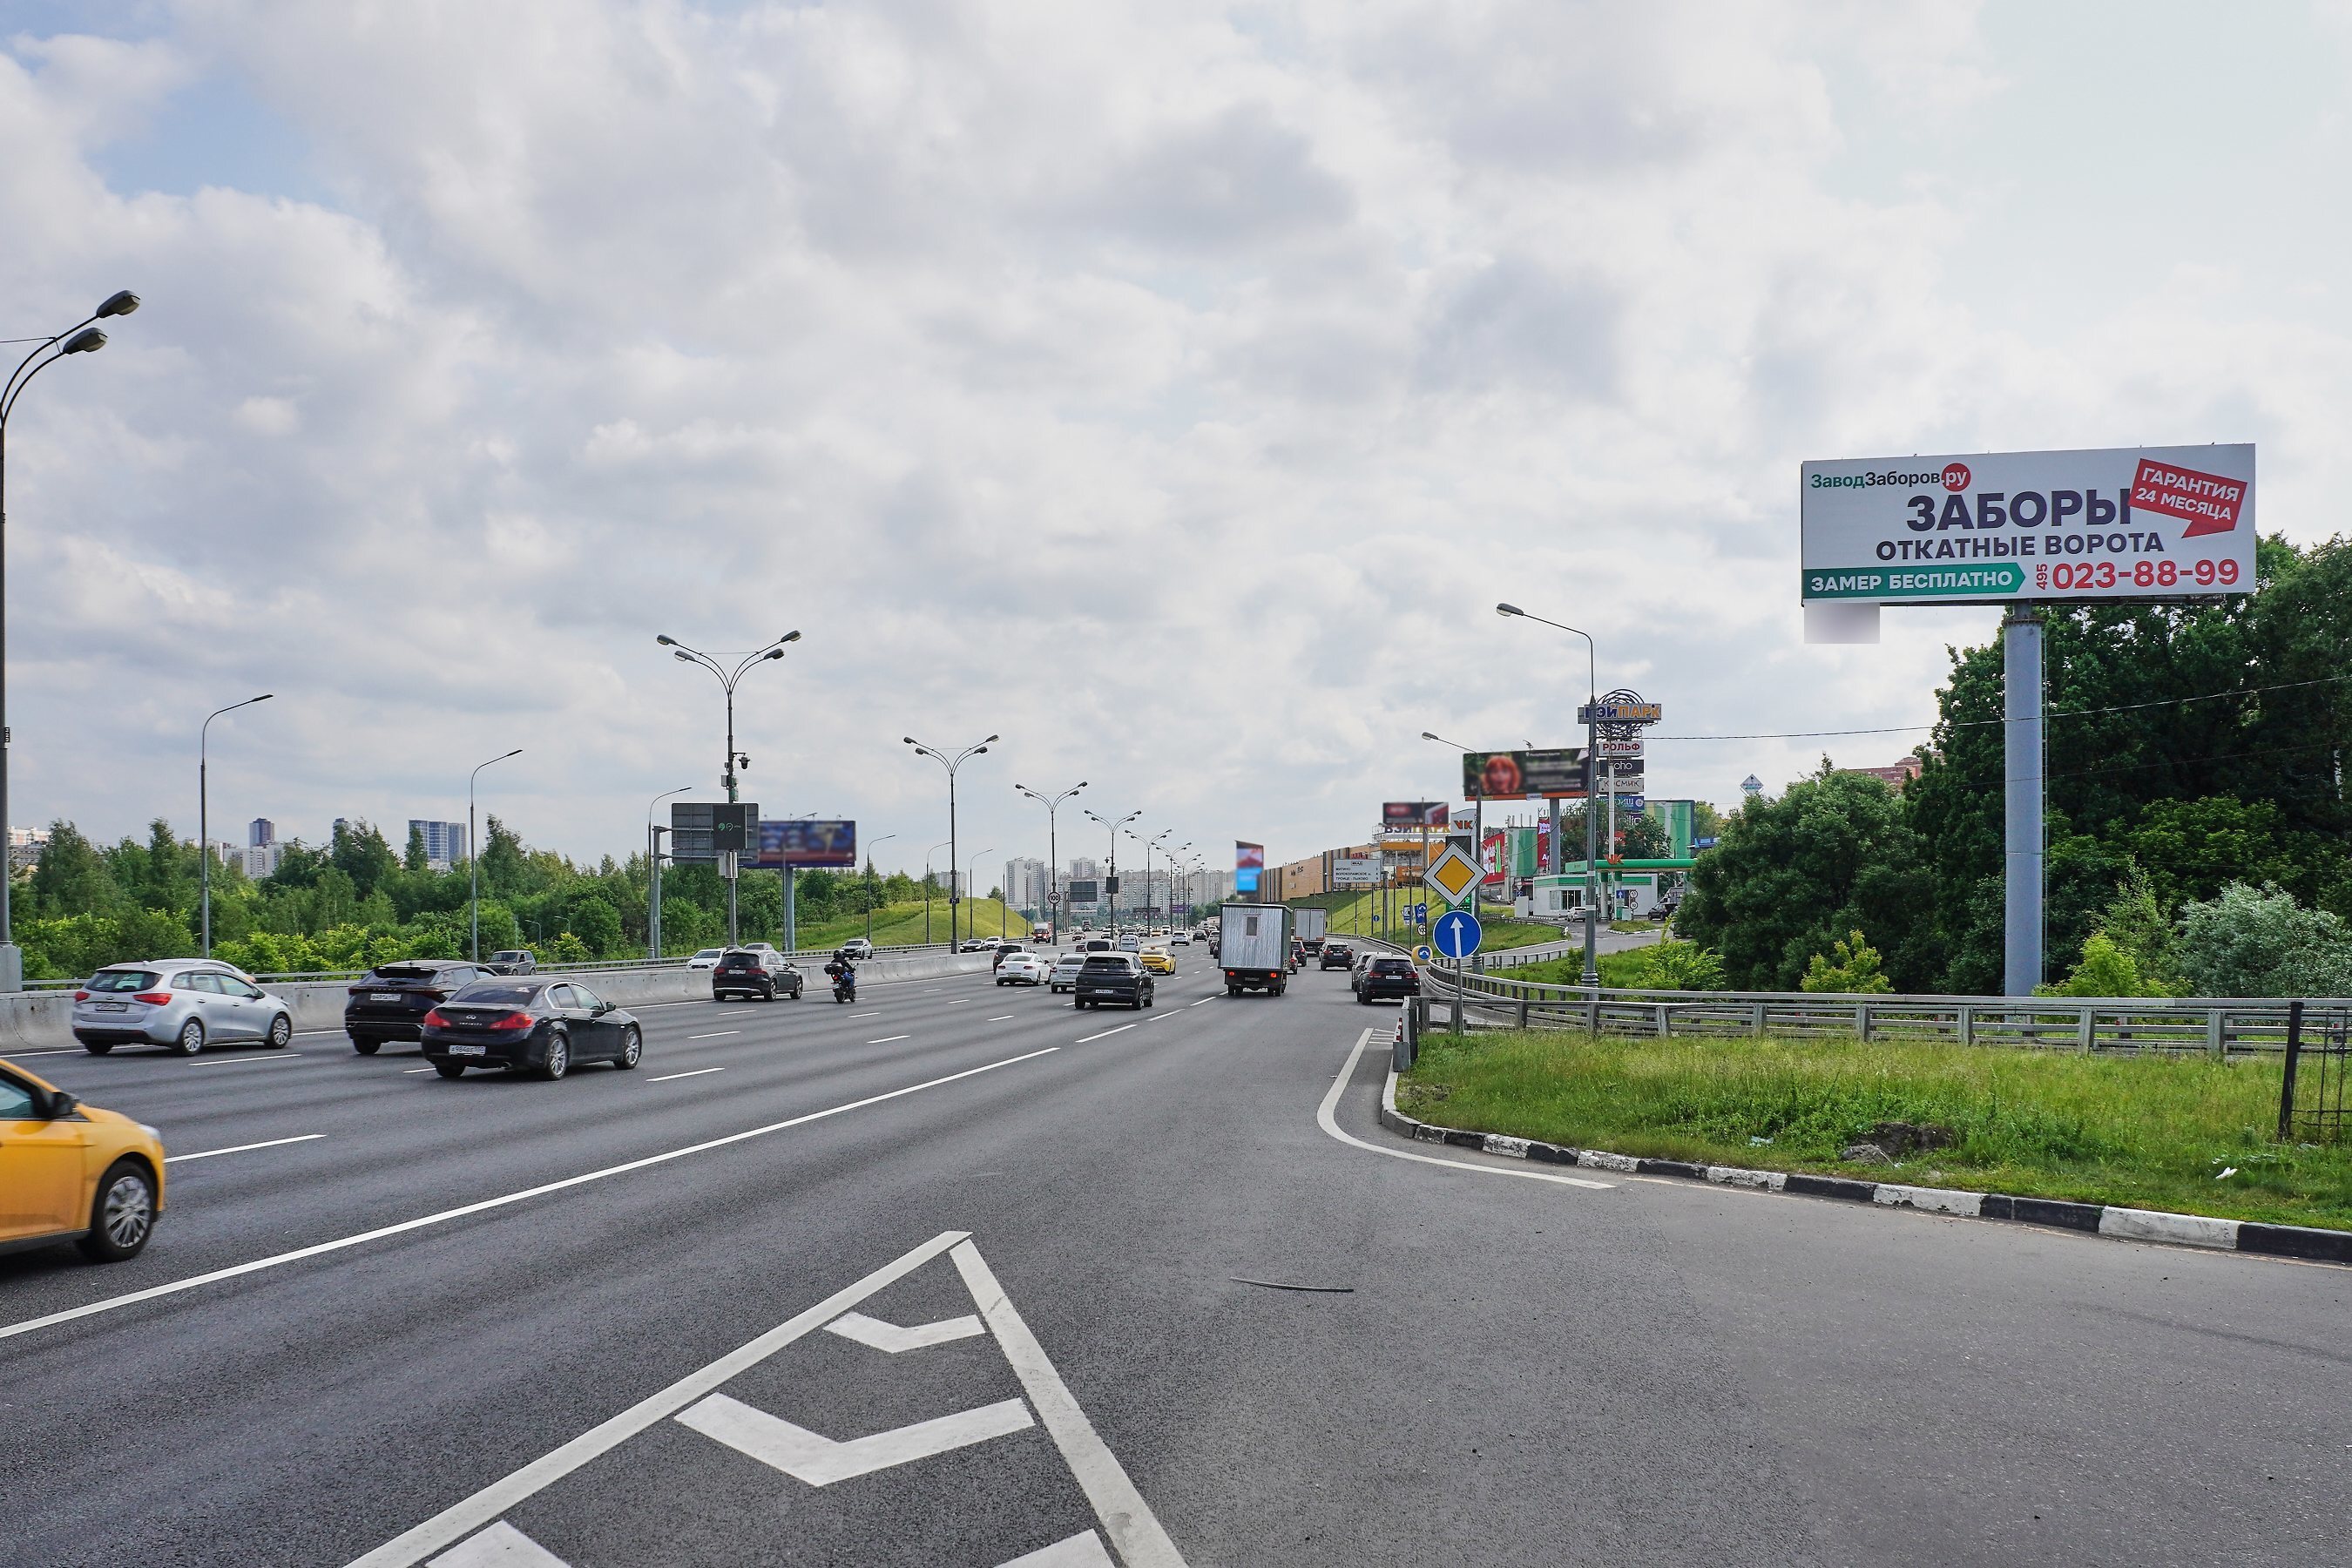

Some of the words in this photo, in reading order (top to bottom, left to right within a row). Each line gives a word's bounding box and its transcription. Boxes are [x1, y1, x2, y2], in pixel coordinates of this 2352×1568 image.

[1811, 470, 1967, 490] ЗаводЗаборов.ру
[2141, 467, 2240, 502] ГАРАНТИЯ
[1906, 488, 2131, 532] ЗАБОРЫ
[2135, 487, 2156, 503] 24
[2160, 493, 2232, 520] МЕСЯЦА
[1876, 536, 2036, 561] ОТКАТНЫЕ
[2044, 532, 2165, 555] ВОРОТА
[1810, 575, 1882, 591] ЗАМЕР
[1889, 571, 2013, 590] БЕСПЛАТНО
[2036, 563, 2048, 591] 495
[2052, 558, 2239, 590] 023-88-99
[1603, 742, 1640, 751] РОЛЬФ
